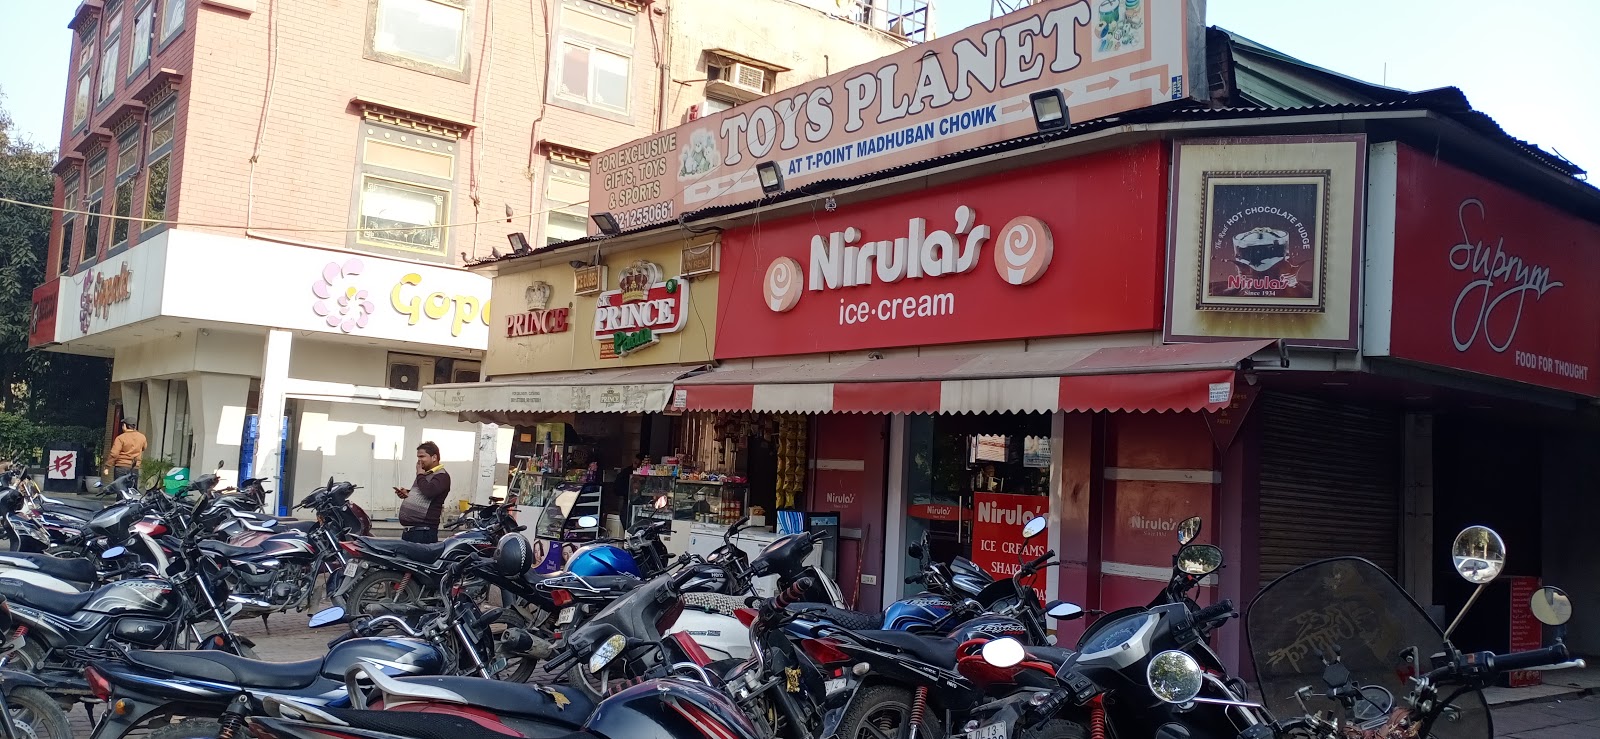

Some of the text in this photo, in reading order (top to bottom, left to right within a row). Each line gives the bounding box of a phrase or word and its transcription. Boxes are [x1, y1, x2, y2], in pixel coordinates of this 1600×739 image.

[720, 1, 1091, 166] TOYS PLANET
[596, 132, 677, 175] FOR EXCLUSIVE
[788, 105, 998, 176] AT T-POINT MADHUBAN CHOWK
[604, 157, 667, 191] GIFTS, TOYS
[608, 180, 660, 210] & SPORTS
[1226, 211, 1244, 226] HOT
[1245, 206, 1298, 224] CHOCOLATE
[1295, 222, 1310, 250] FUDGE
[809, 204, 991, 292] Nirula's
[1228, 272, 1290, 290] Nirula's
[1449, 198, 1564, 352] Suprym
[505, 307, 569, 338] PRINCE
[595, 298, 676, 332] PRINCE
[613, 327, 656, 356] Paan
[1515, 350, 1589, 381] FOOD FOR THOUGHT
[826, 492, 854, 504] Nirula's
[926, 505, 950, 516] Nirula's
[1131, 515, 1177, 531] Nirula's
[981, 539, 1045, 557] ICE CREAMS
[991, 561, 1021, 575] SHAK
